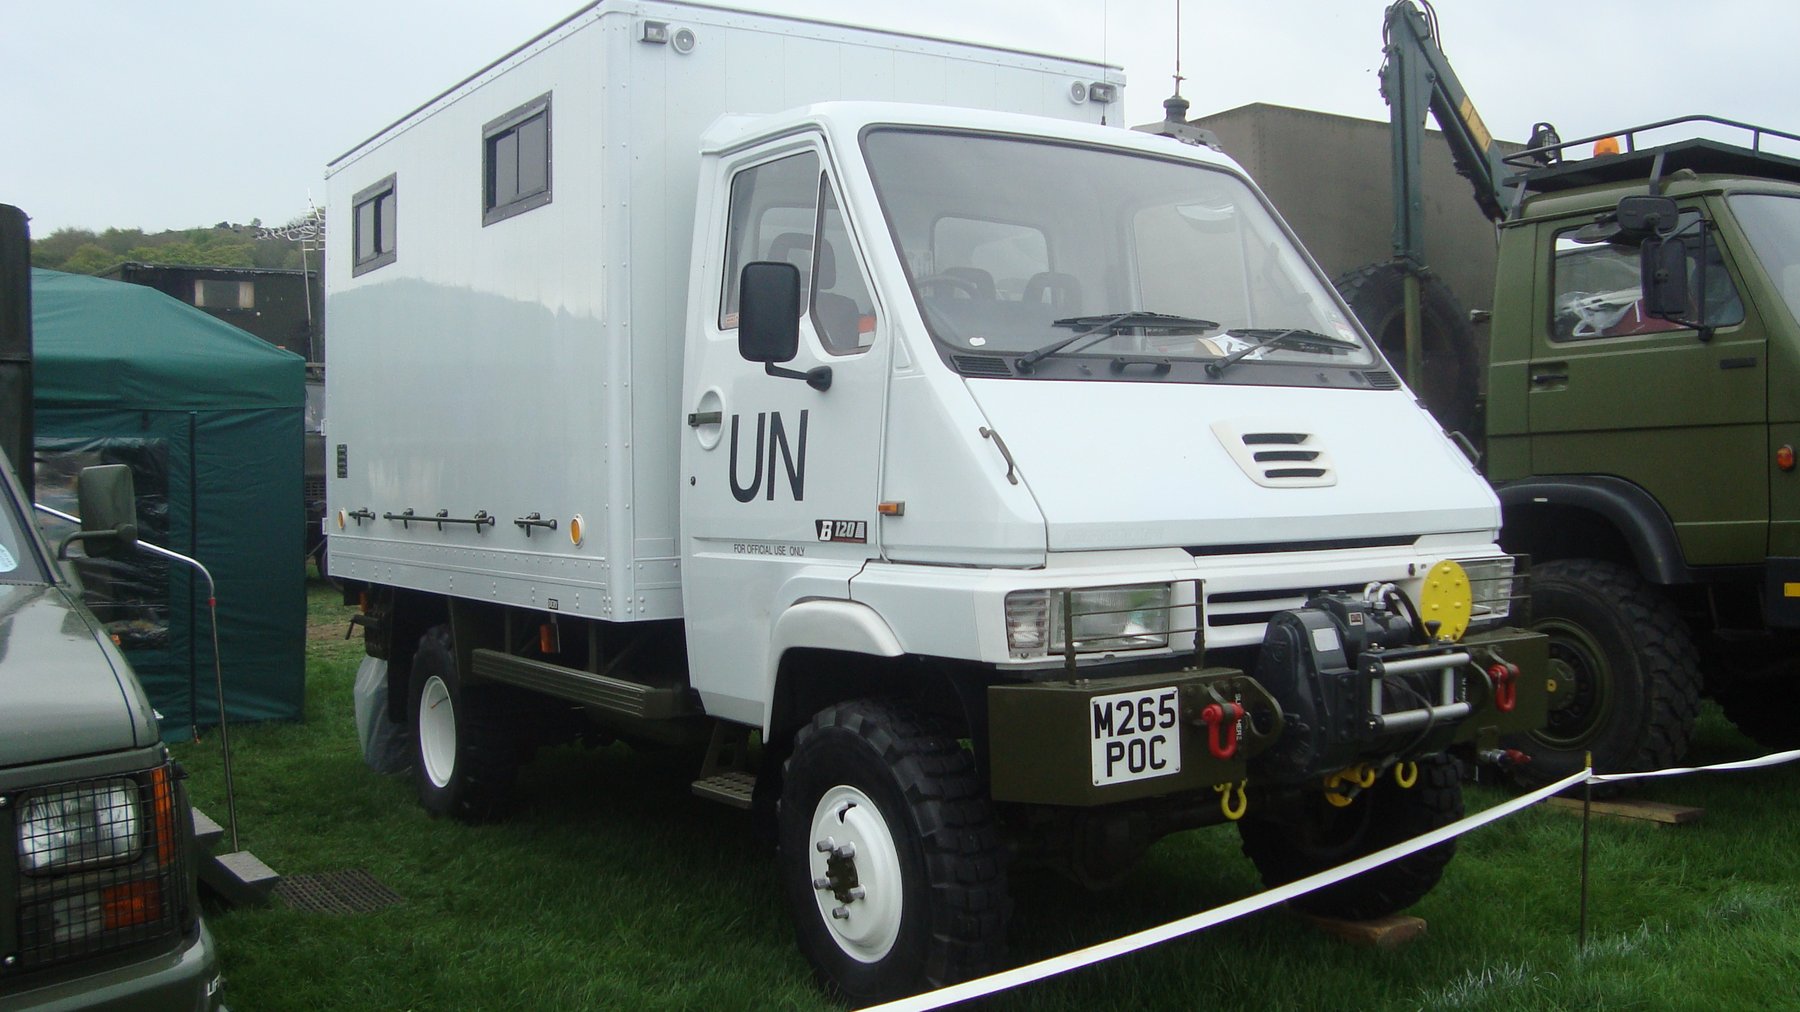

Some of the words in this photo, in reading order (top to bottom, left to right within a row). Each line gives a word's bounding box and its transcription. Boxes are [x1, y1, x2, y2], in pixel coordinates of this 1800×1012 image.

[729, 409, 809, 503] UN
[733, 543, 746, 554] FOR
[746, 544, 773, 556] OFFICIAL
[774, 545, 787, 556] USE
[789, 546, 806, 557] ONLY
[819, 520, 833, 541] B
[834, 521, 856, 538] 120
[1093, 693, 1176, 739] M265
[1106, 734, 1167, 777] POC
